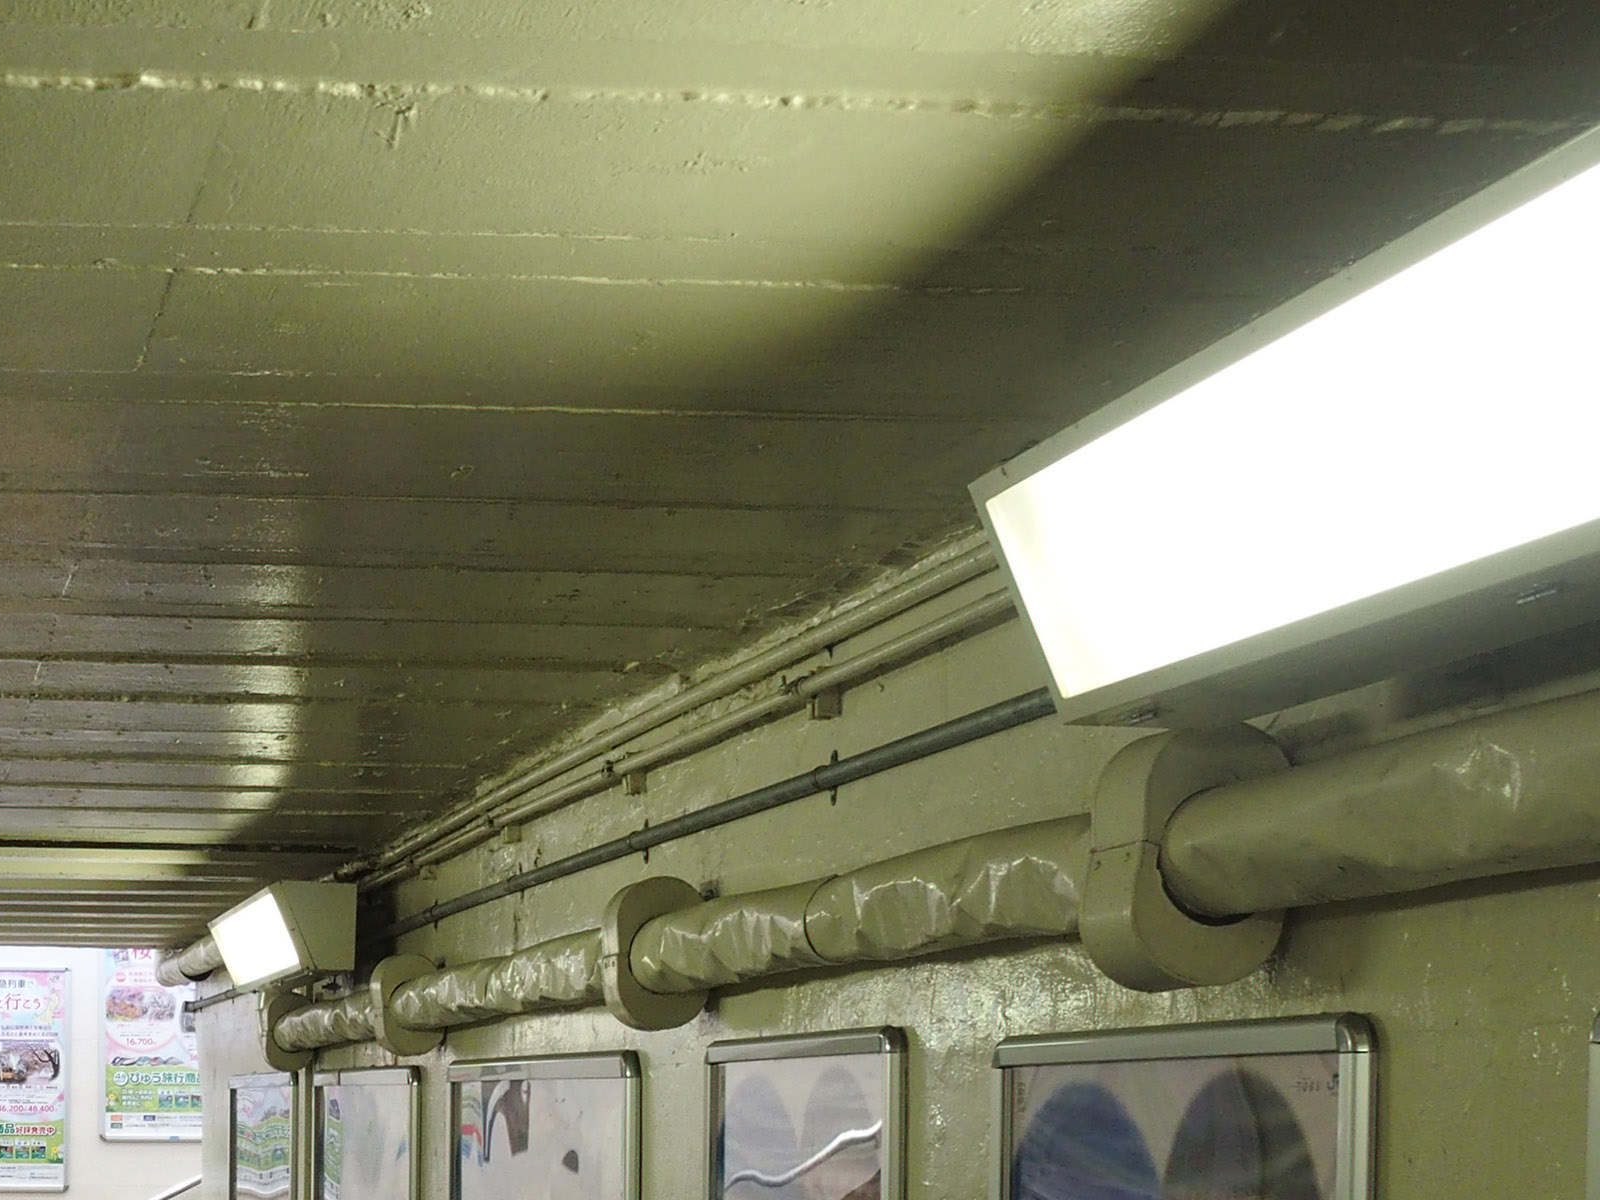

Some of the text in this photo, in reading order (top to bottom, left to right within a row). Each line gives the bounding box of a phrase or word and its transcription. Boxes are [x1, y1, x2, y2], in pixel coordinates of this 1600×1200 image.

[15, 1125, 55, 1135] 好評発売中
